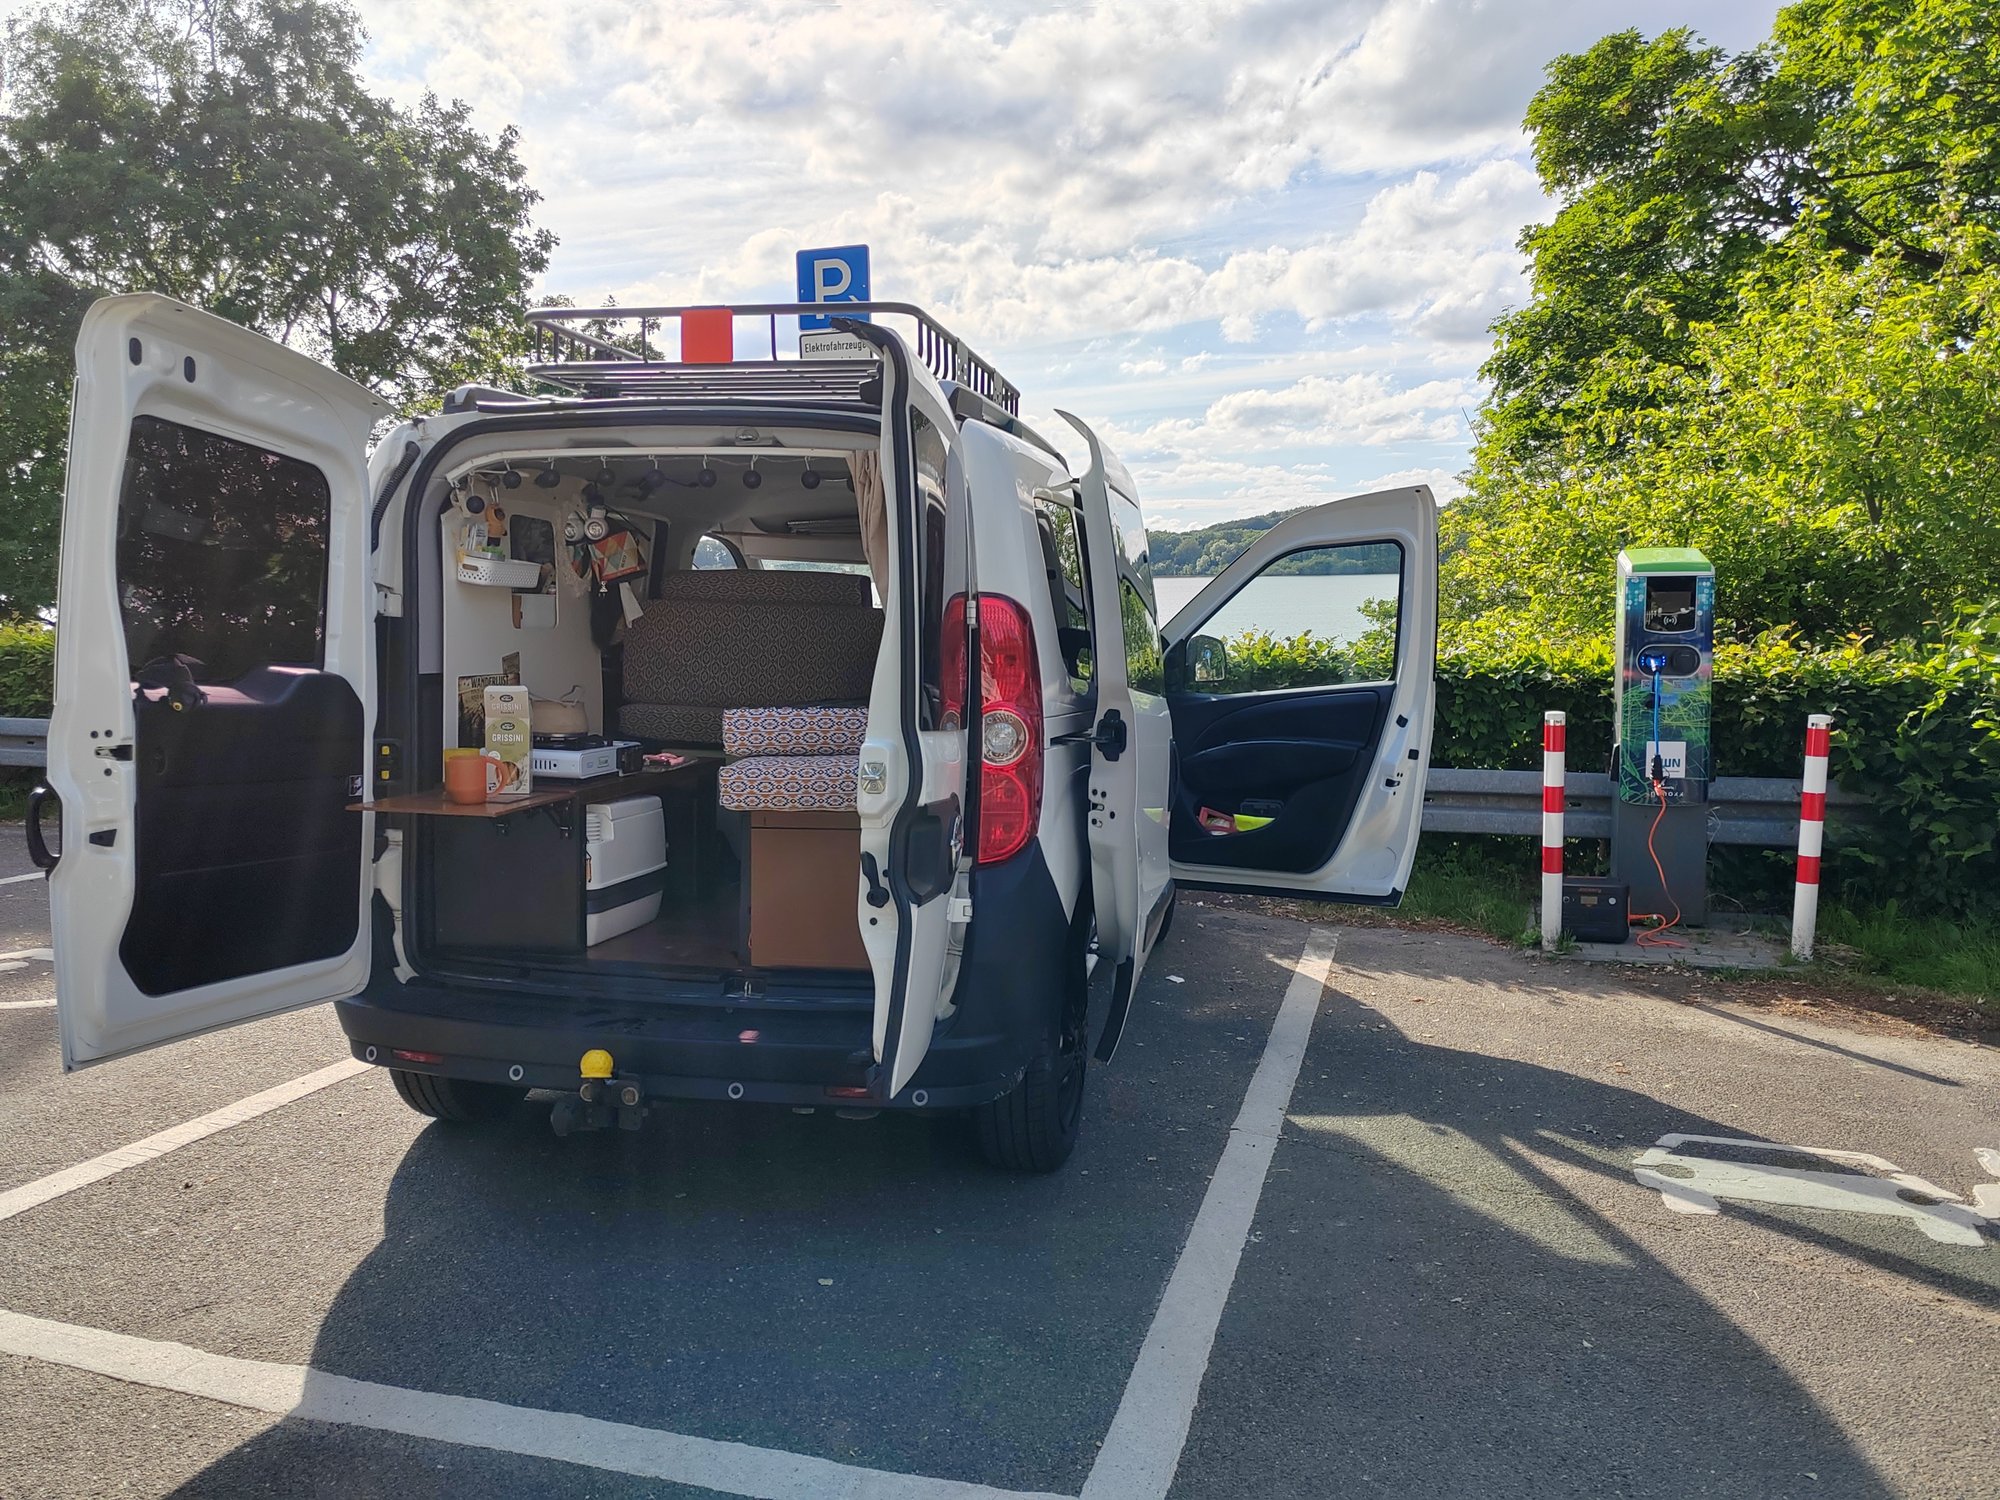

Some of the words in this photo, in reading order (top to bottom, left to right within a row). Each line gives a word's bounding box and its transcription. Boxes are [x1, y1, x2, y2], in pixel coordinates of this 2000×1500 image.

[814, 258, 852, 320] P
[491, 703, 522, 711] GRISSINI
[492, 733, 524, 742] GRISSINI
